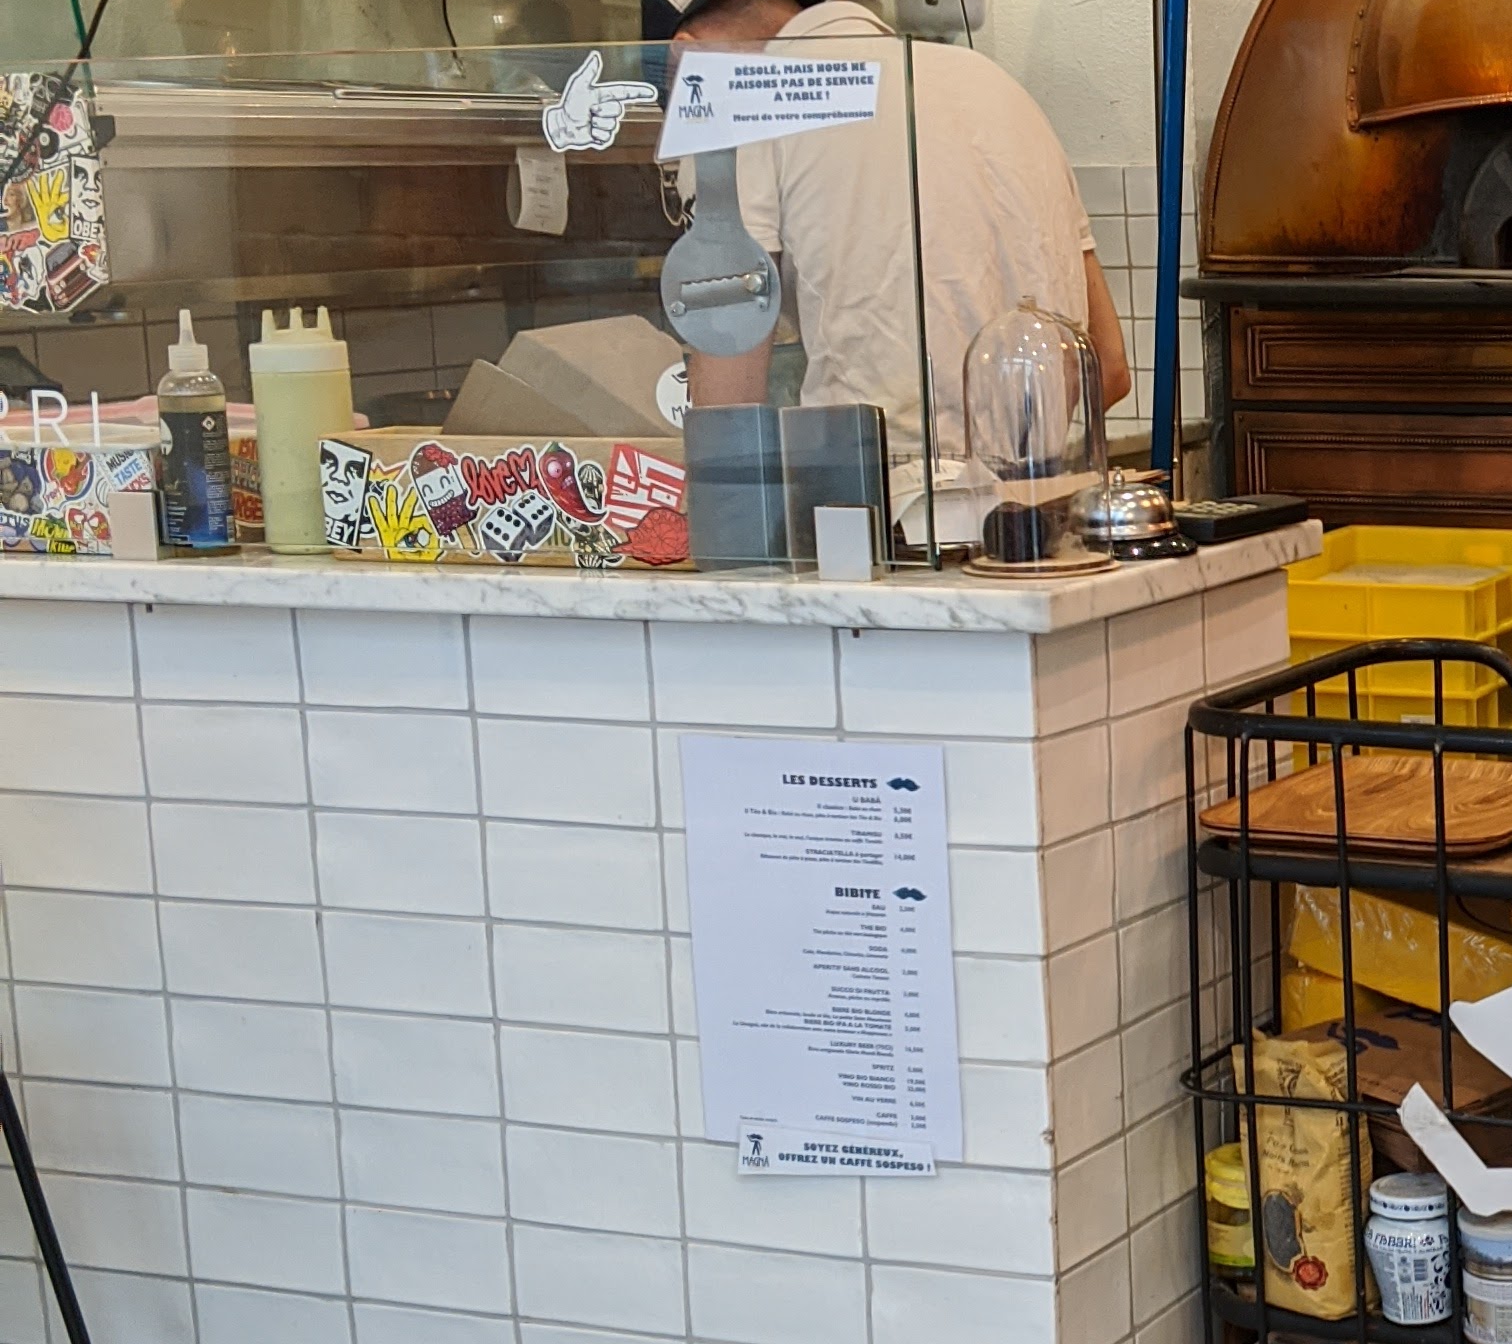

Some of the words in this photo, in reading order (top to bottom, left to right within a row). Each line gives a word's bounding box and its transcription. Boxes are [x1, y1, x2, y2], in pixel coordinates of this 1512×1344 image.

[784, 64, 814, 74] MAIS
[817, 63, 847, 73] NOUS
[851, 62, 866, 71] NE
[729, 79, 777, 90] FAISONS
[781, 78, 804, 88] PAS
[808, 77, 822, 87] DE
[826, 76, 874, 86] SERVICE
[786, 91, 823, 101] TABLE
[733, 113, 759, 123] Merci
[762, 113, 772, 122] de
[775, 113, 799, 122] votre
[802, 110, 873, 122] compréhension
[114, 458, 143, 485] TASTE
[782, 774, 805, 785] LES
[810, 776, 877, 788] DESSERTS
[835, 887, 881, 899] BIBITE
[803, 1142, 839, 1153] SOYEZ
[778, 1152, 818, 1164] OFFREZ
[821, 1156, 836, 1165] UN
[876, 1160, 924, 1172] SOSPESO
